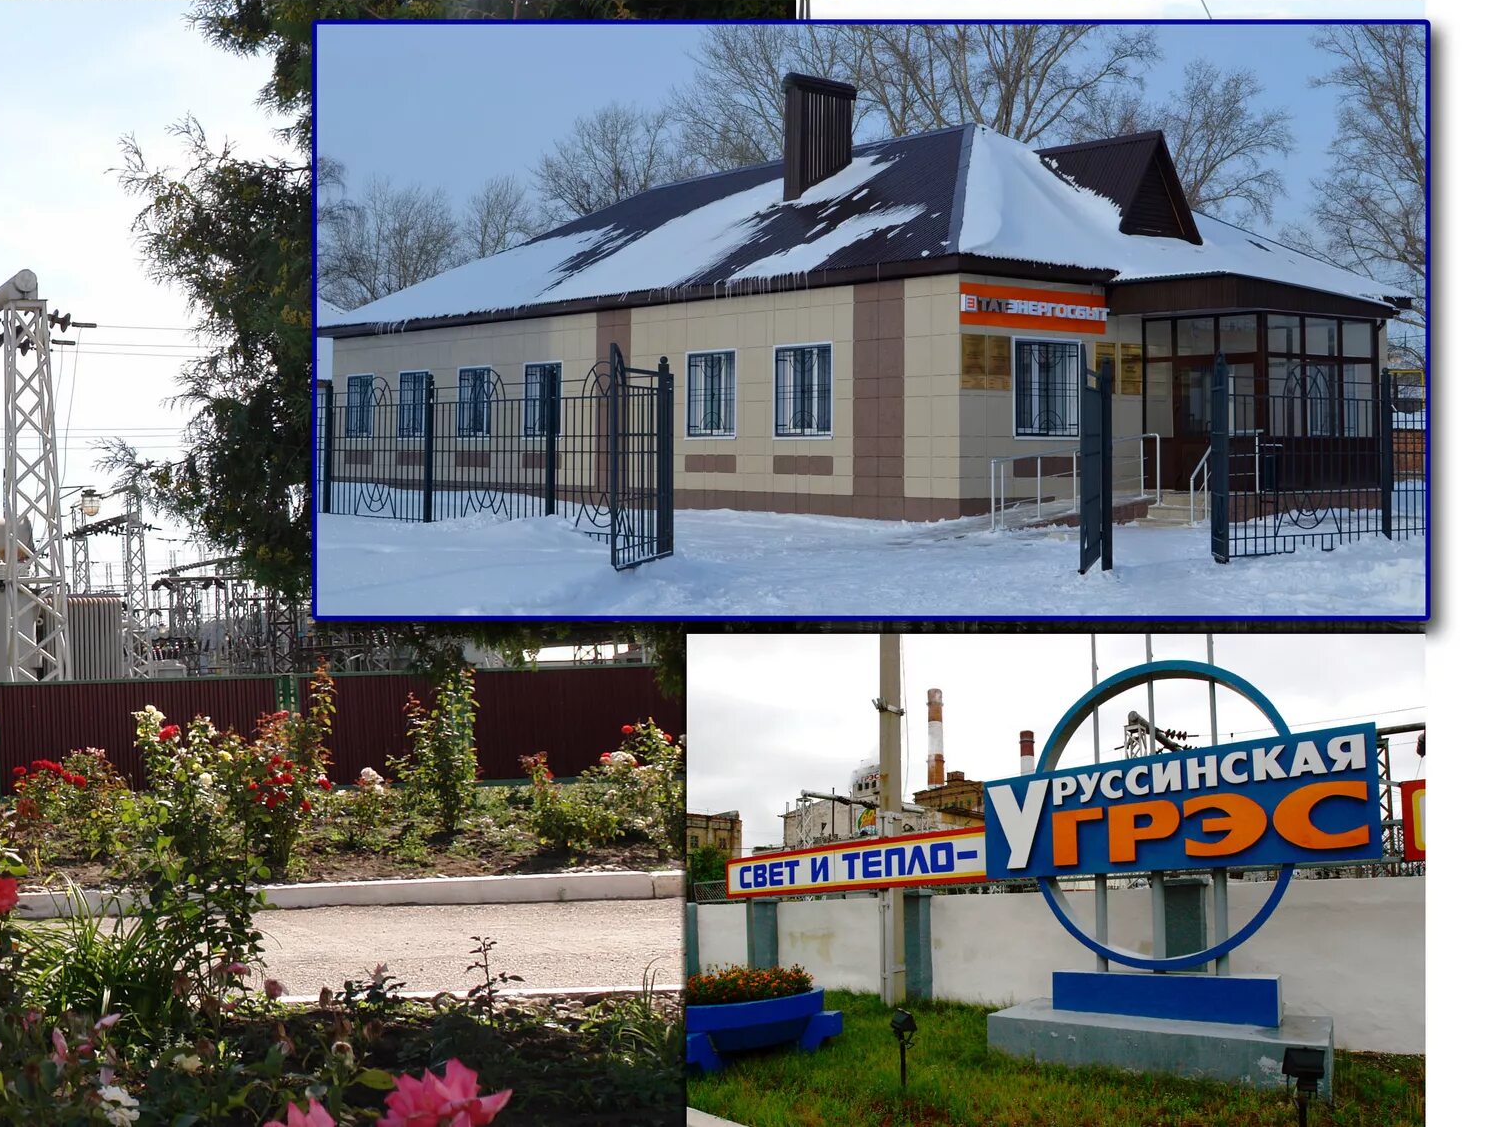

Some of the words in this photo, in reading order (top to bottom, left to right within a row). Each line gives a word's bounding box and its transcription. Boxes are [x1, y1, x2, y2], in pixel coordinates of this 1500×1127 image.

[978, 297, 1110, 322] ТАТЭНЕРГОСБЫТ
[987, 733, 1367, 869] УРУССИНСКАЯ
[1051, 780, 1370, 867] ГРЭС
[739, 859, 800, 890] СВЕТ
[811, 855, 829, 883] И
[842, 841, 979, 880] ТЕПЛО-
